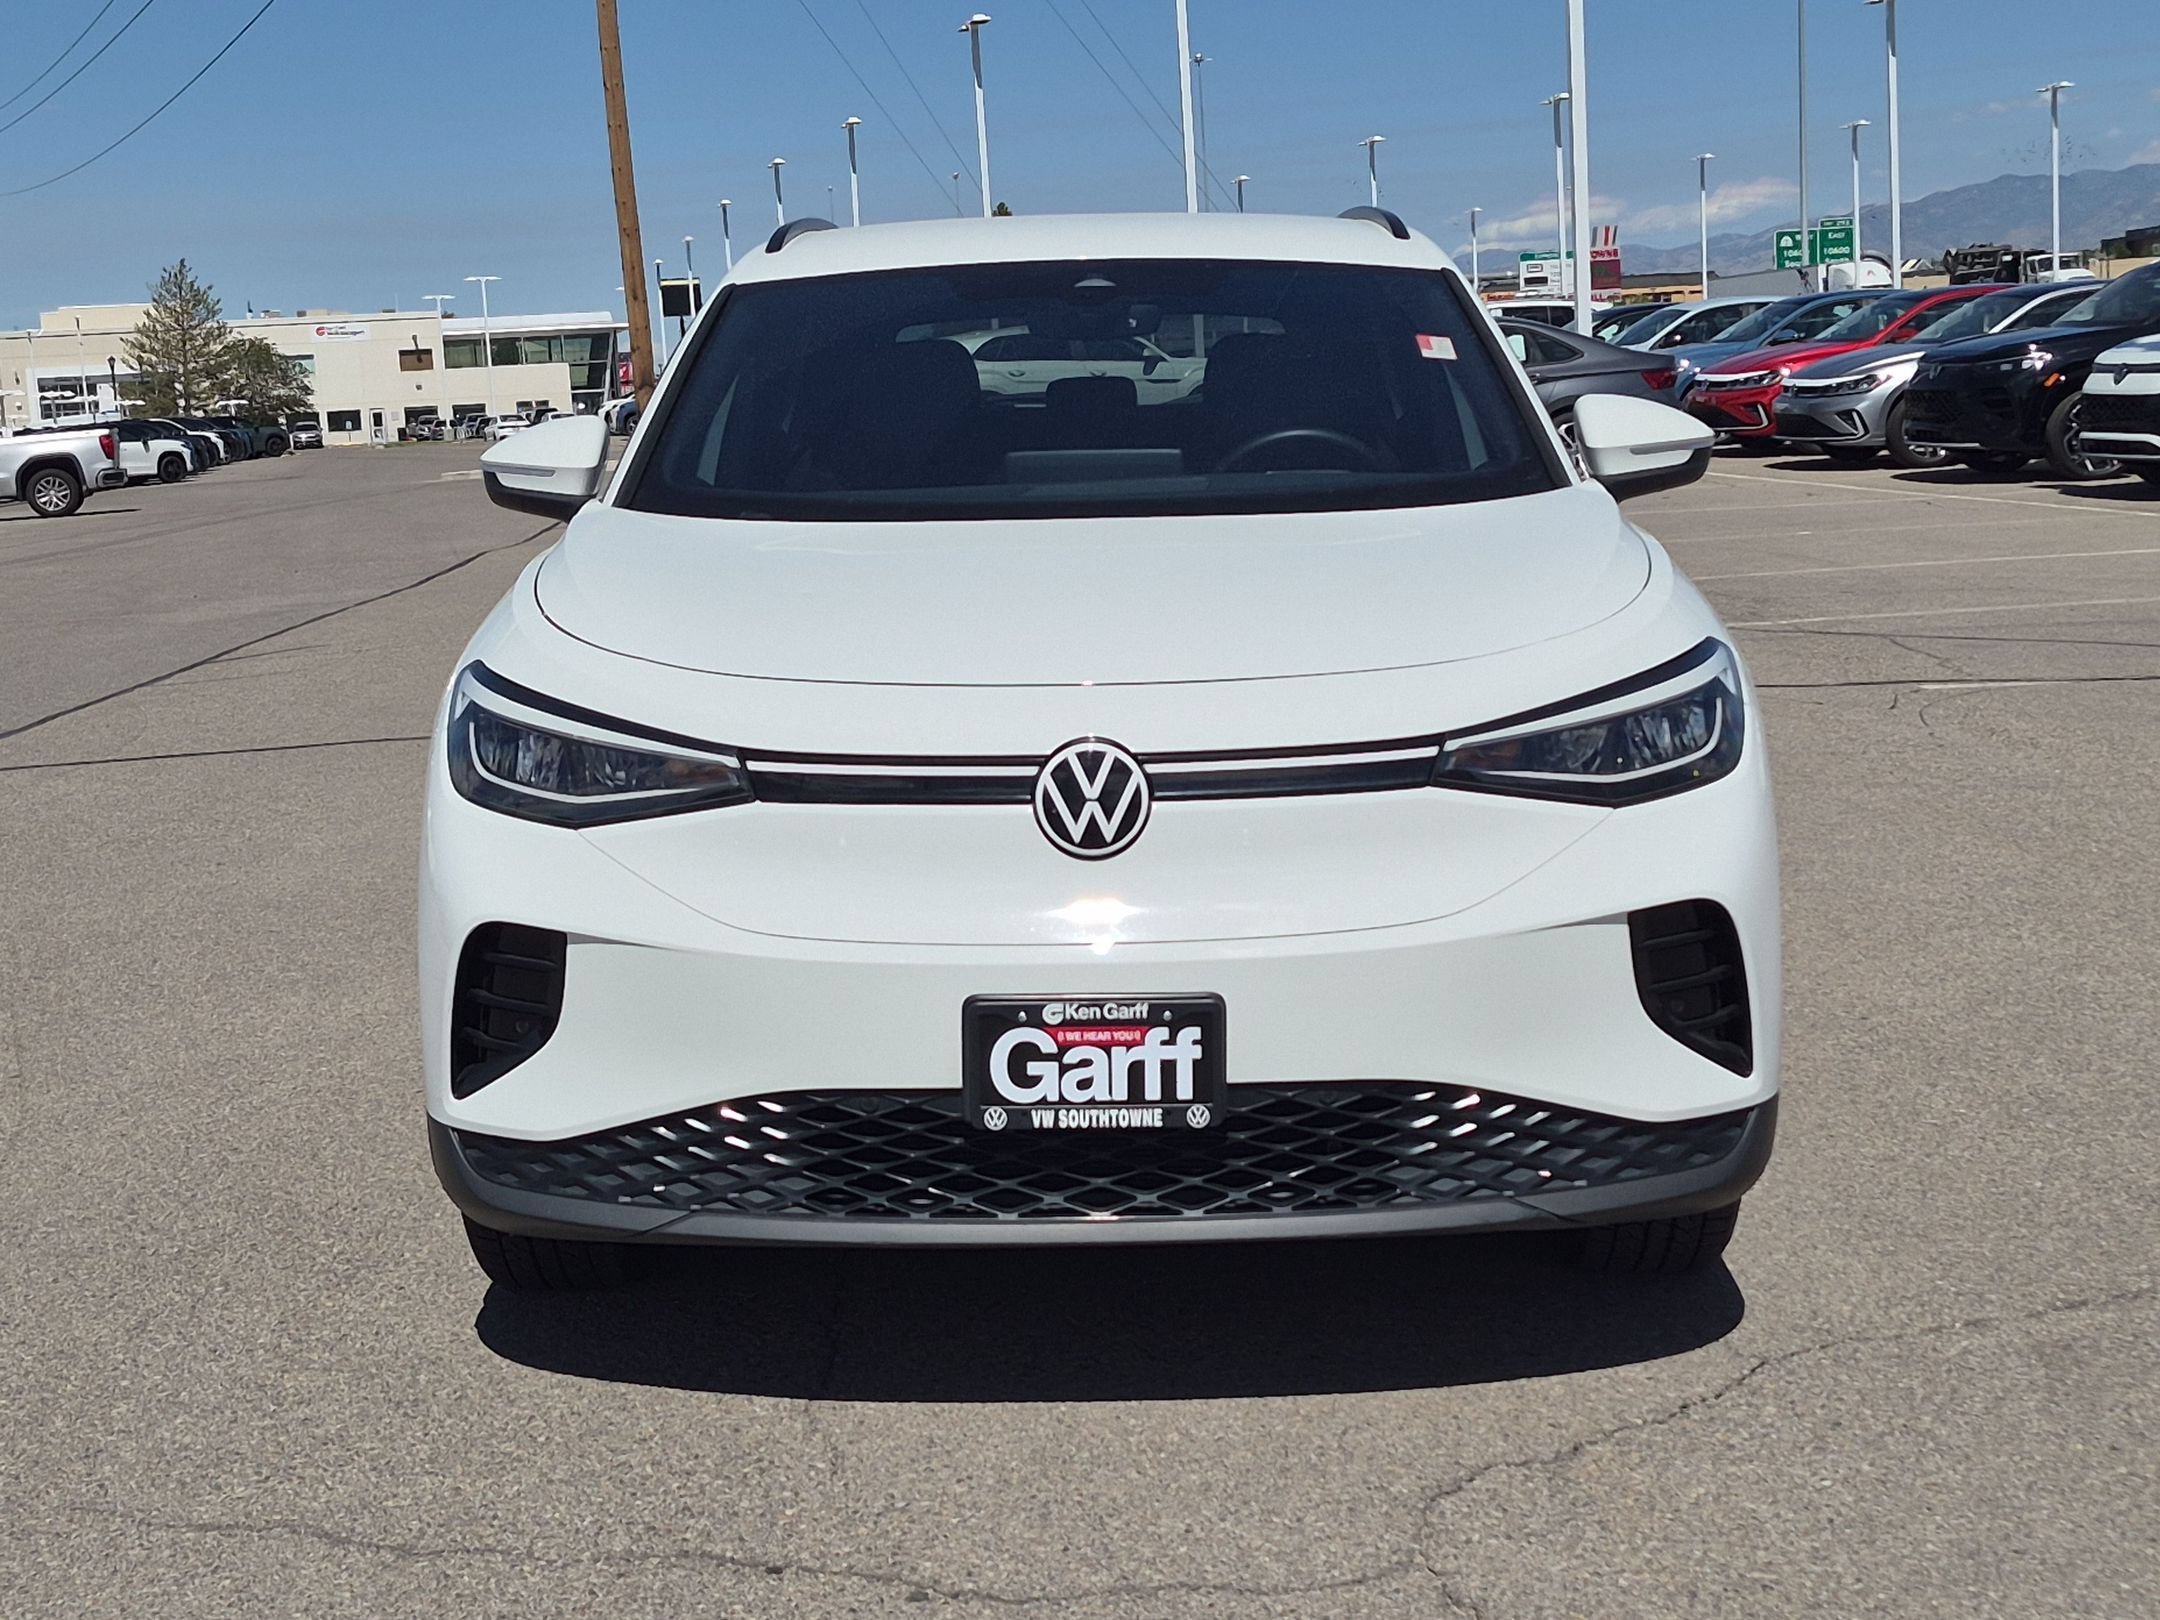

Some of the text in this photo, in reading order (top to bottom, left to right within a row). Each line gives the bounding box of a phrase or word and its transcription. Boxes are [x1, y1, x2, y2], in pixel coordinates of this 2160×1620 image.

[1037, 745, 1146, 853] VW
[1065, 1002, 1101, 1020] Ken
[1103, 1002, 1149, 1020] Garff
[1065, 1030, 1134, 1041] WE HEAR YOU
[989, 1026, 1202, 1104] Garff
[1030, 1108, 1163, 1129] VW SOUTHTOWNE
